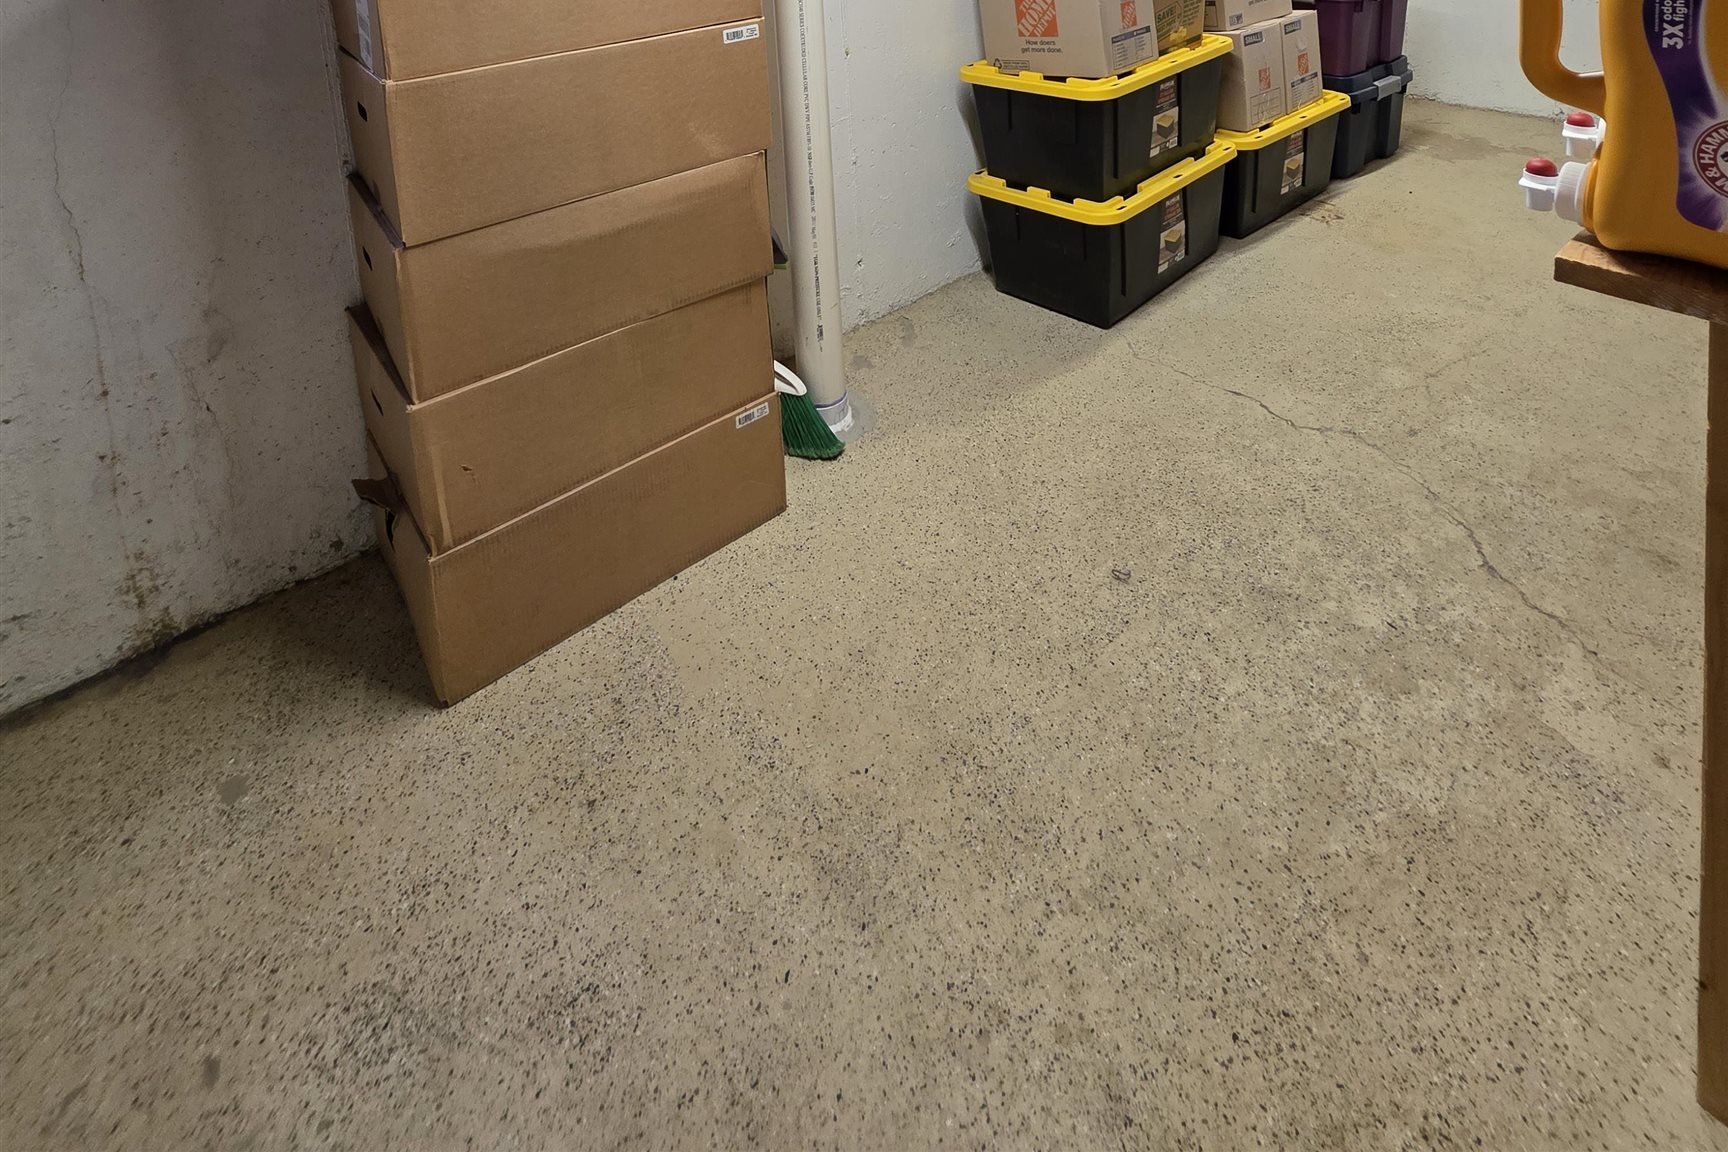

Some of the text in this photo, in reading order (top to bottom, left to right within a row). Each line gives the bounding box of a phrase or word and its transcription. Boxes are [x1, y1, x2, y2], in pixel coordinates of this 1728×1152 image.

[1033, 5, 1057, 37] DEPOT
[1662, 22, 1684, 49] 3X
[1704, 166, 1720, 178] &
